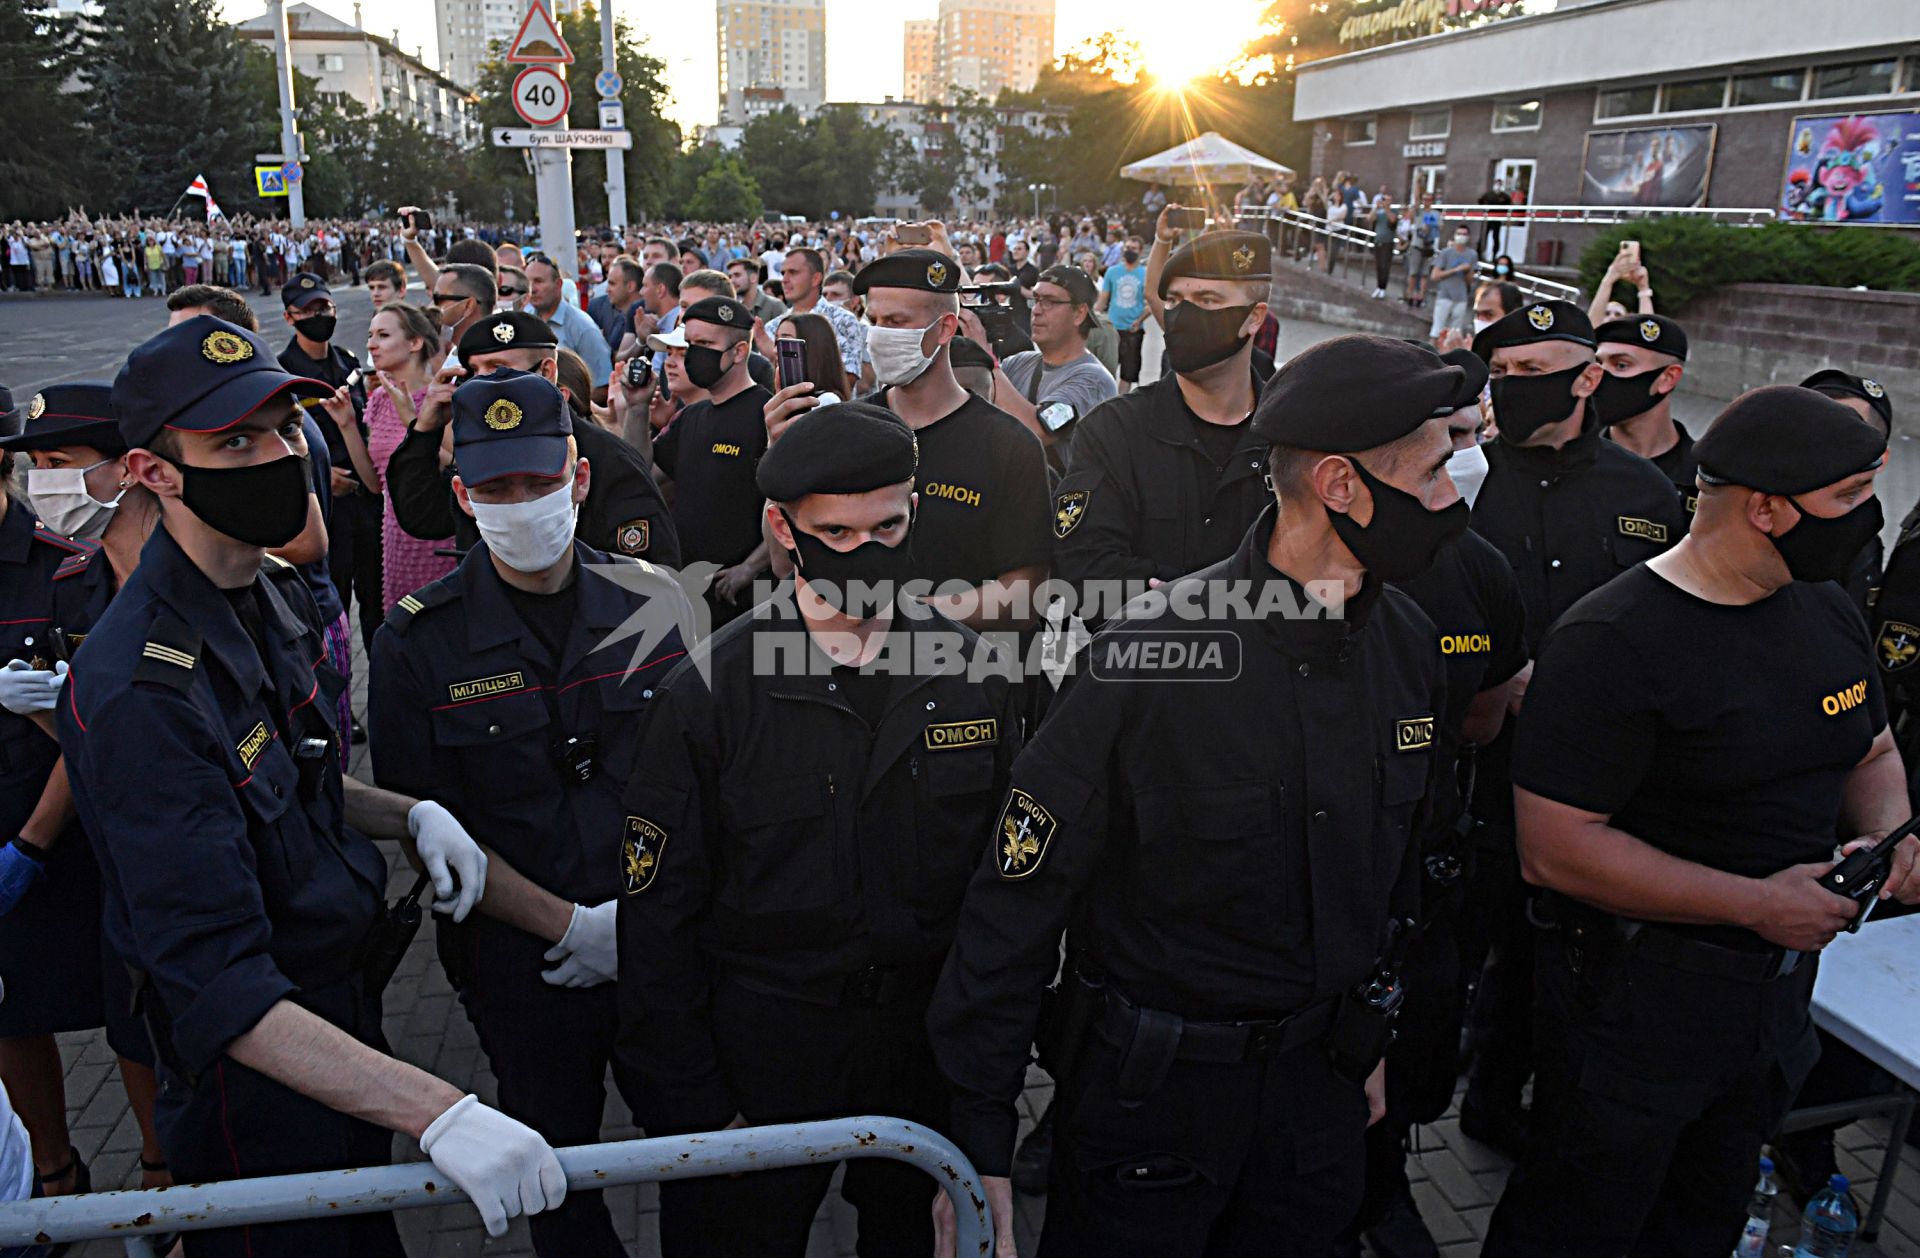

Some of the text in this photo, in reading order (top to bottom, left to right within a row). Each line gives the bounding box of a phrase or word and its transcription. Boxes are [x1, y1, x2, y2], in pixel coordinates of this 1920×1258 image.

[525, 84, 555, 106] 40
[529, 134, 552, 145] бул.
[712, 443, 740, 456] ОМОН
[925, 482, 981, 507] ОМОН
[1440, 634, 1491, 654] ОМОН
[453, 675, 520, 698] МІЛІЦЫЯ
[933, 724, 992, 743] ОМОН
[1402, 723, 1433, 743] ОМО
[1018, 796, 1047, 826] ОМОН
[632, 820, 658, 841] ОМОН
